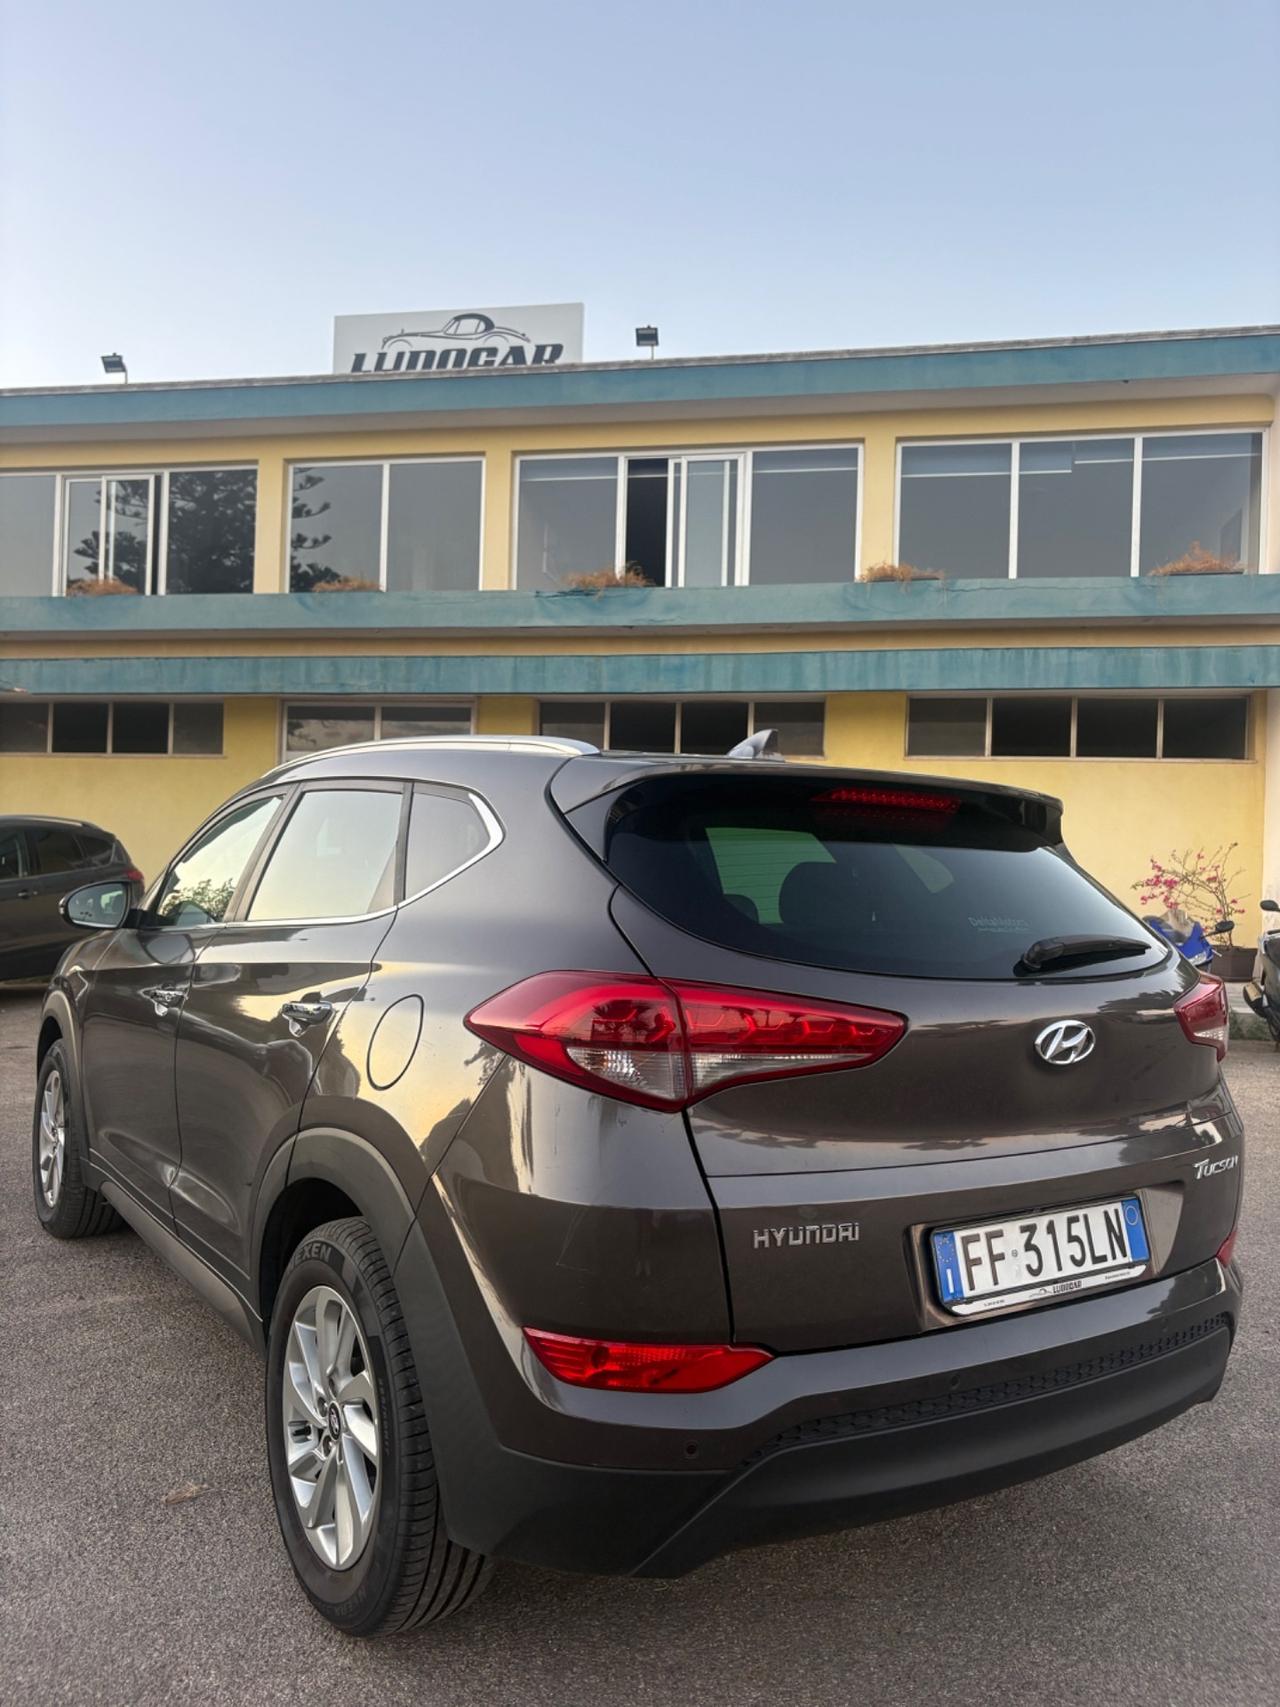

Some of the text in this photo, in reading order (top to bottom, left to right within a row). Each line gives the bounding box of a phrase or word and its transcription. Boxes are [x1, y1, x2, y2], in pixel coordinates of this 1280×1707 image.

[752, 1222, 860, 1249] HYUNDAI
[960, 1208, 1128, 1292] FF 315LN
